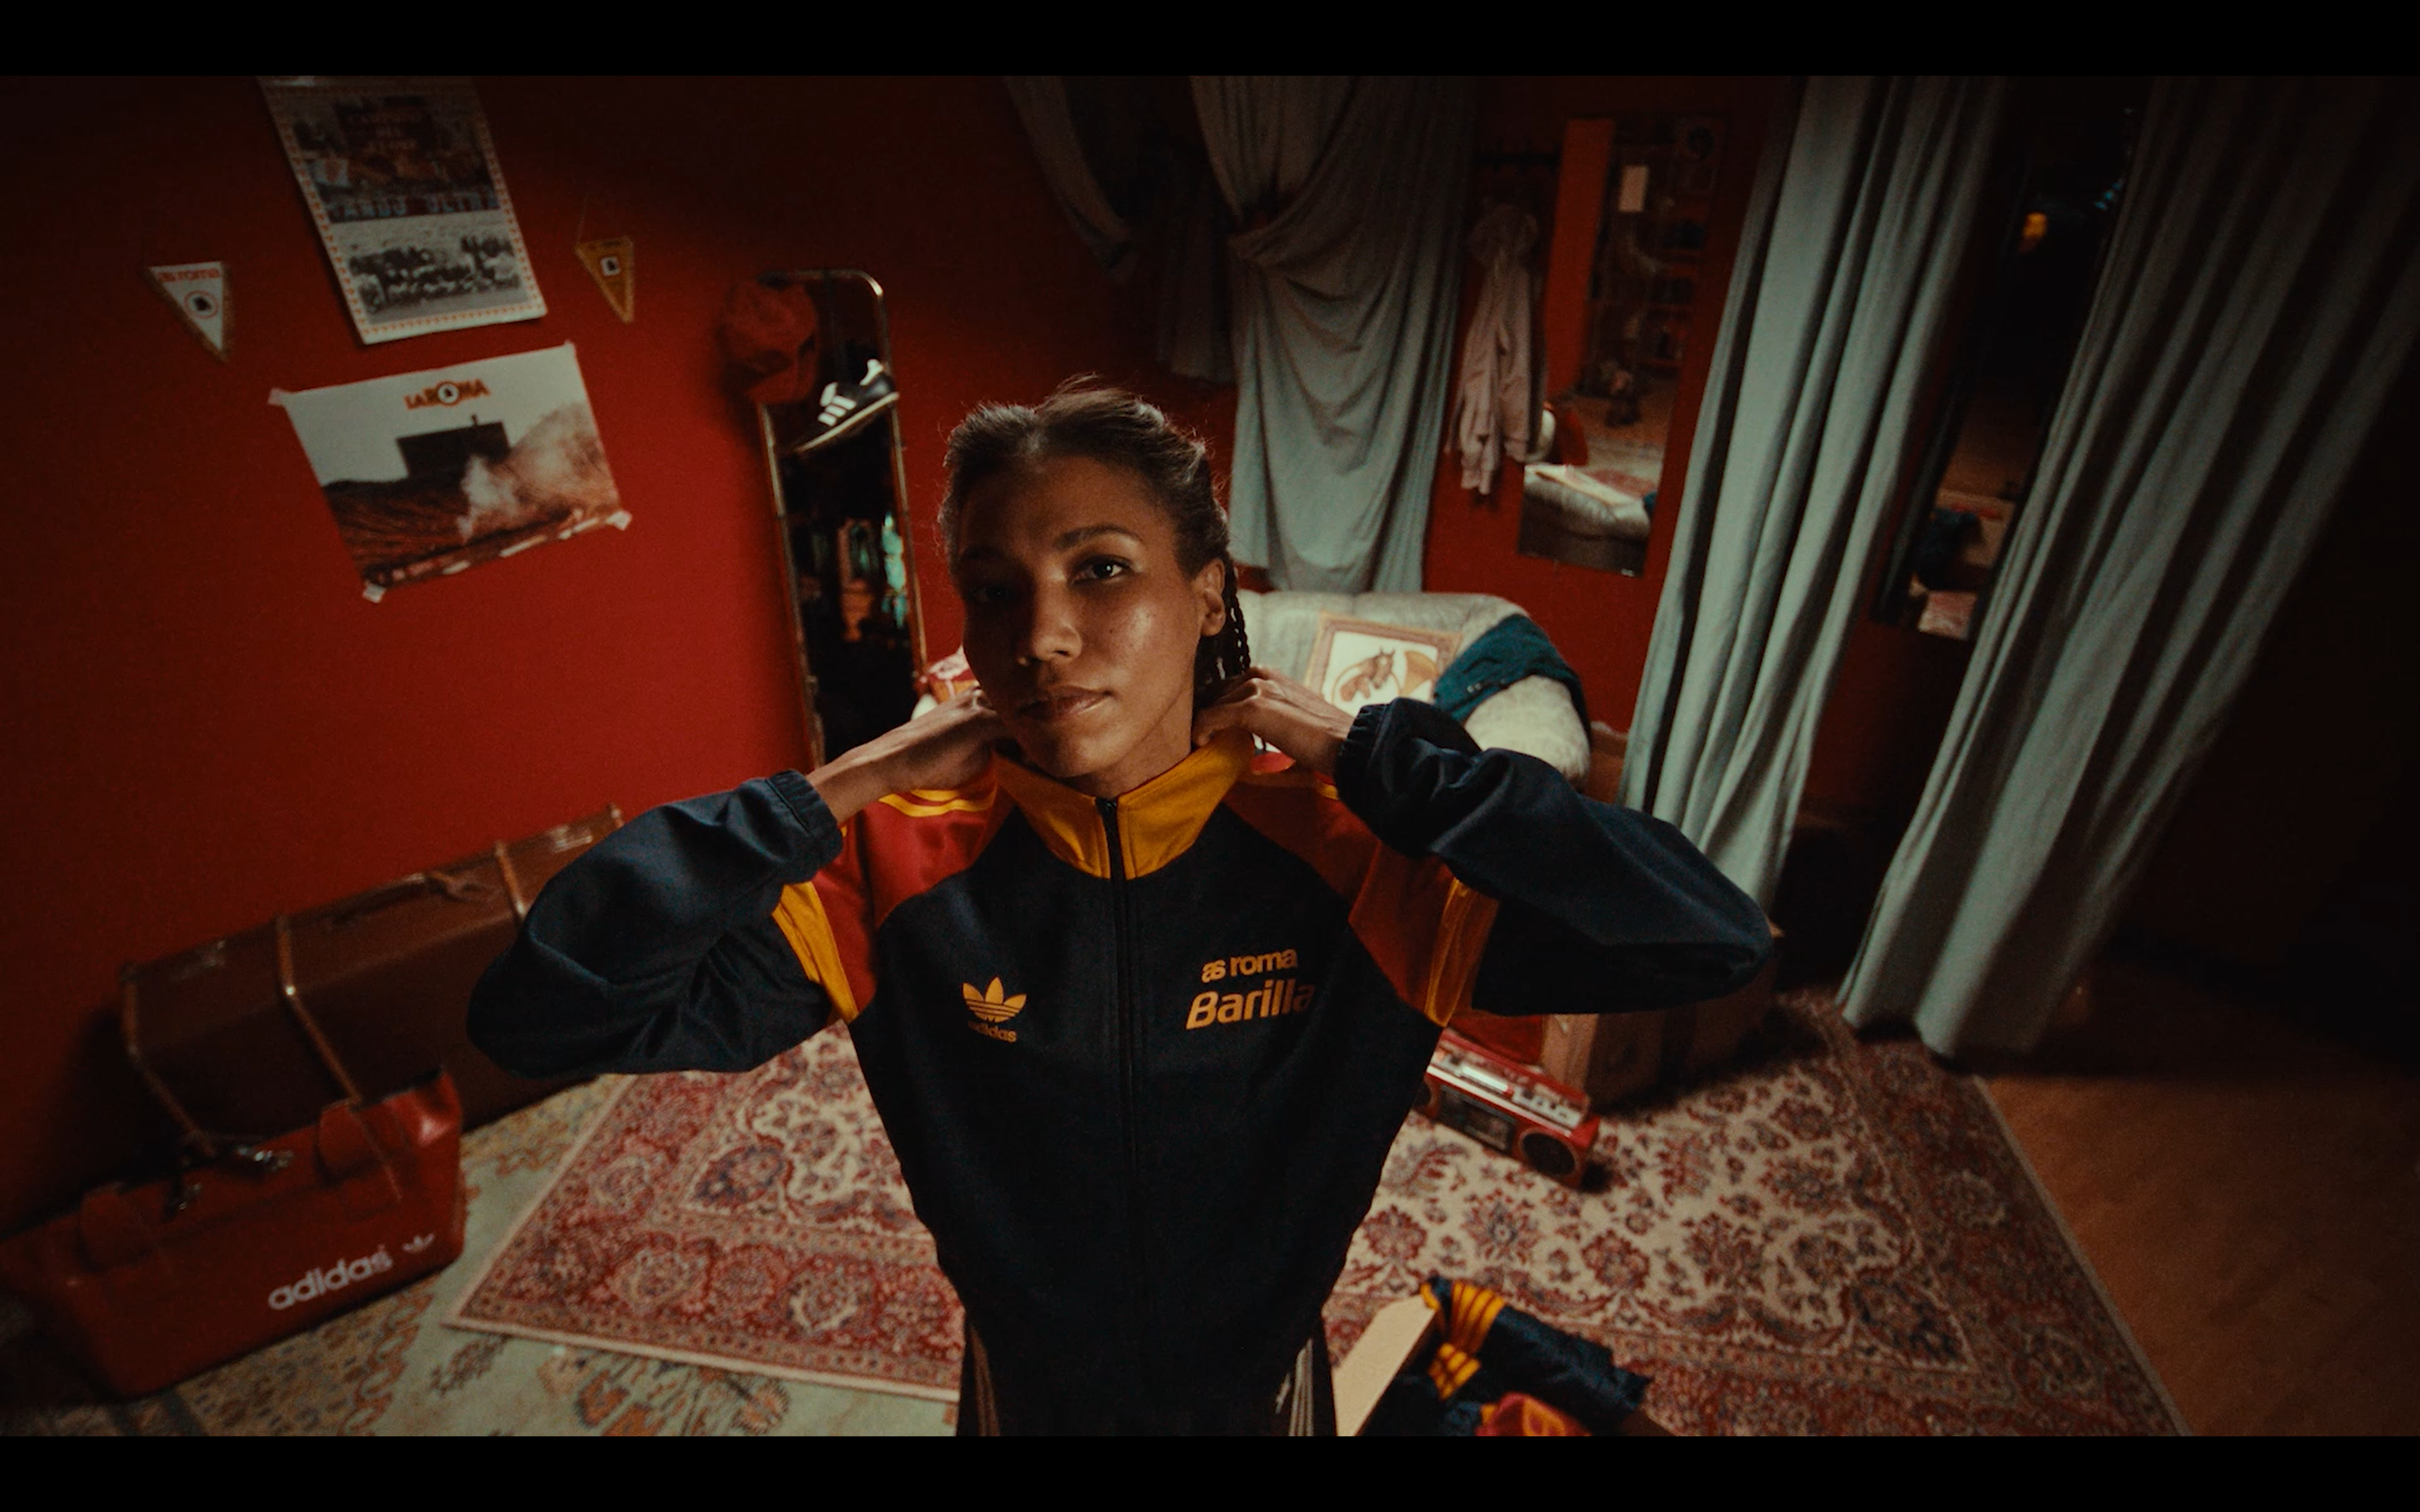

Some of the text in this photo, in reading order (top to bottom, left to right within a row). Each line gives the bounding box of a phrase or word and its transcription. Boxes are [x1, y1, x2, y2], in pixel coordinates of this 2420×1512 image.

[1201, 948, 1298, 983] as roma
[1185, 978, 1315, 1030] Barilla
[268, 1246, 393, 1310] adidas
